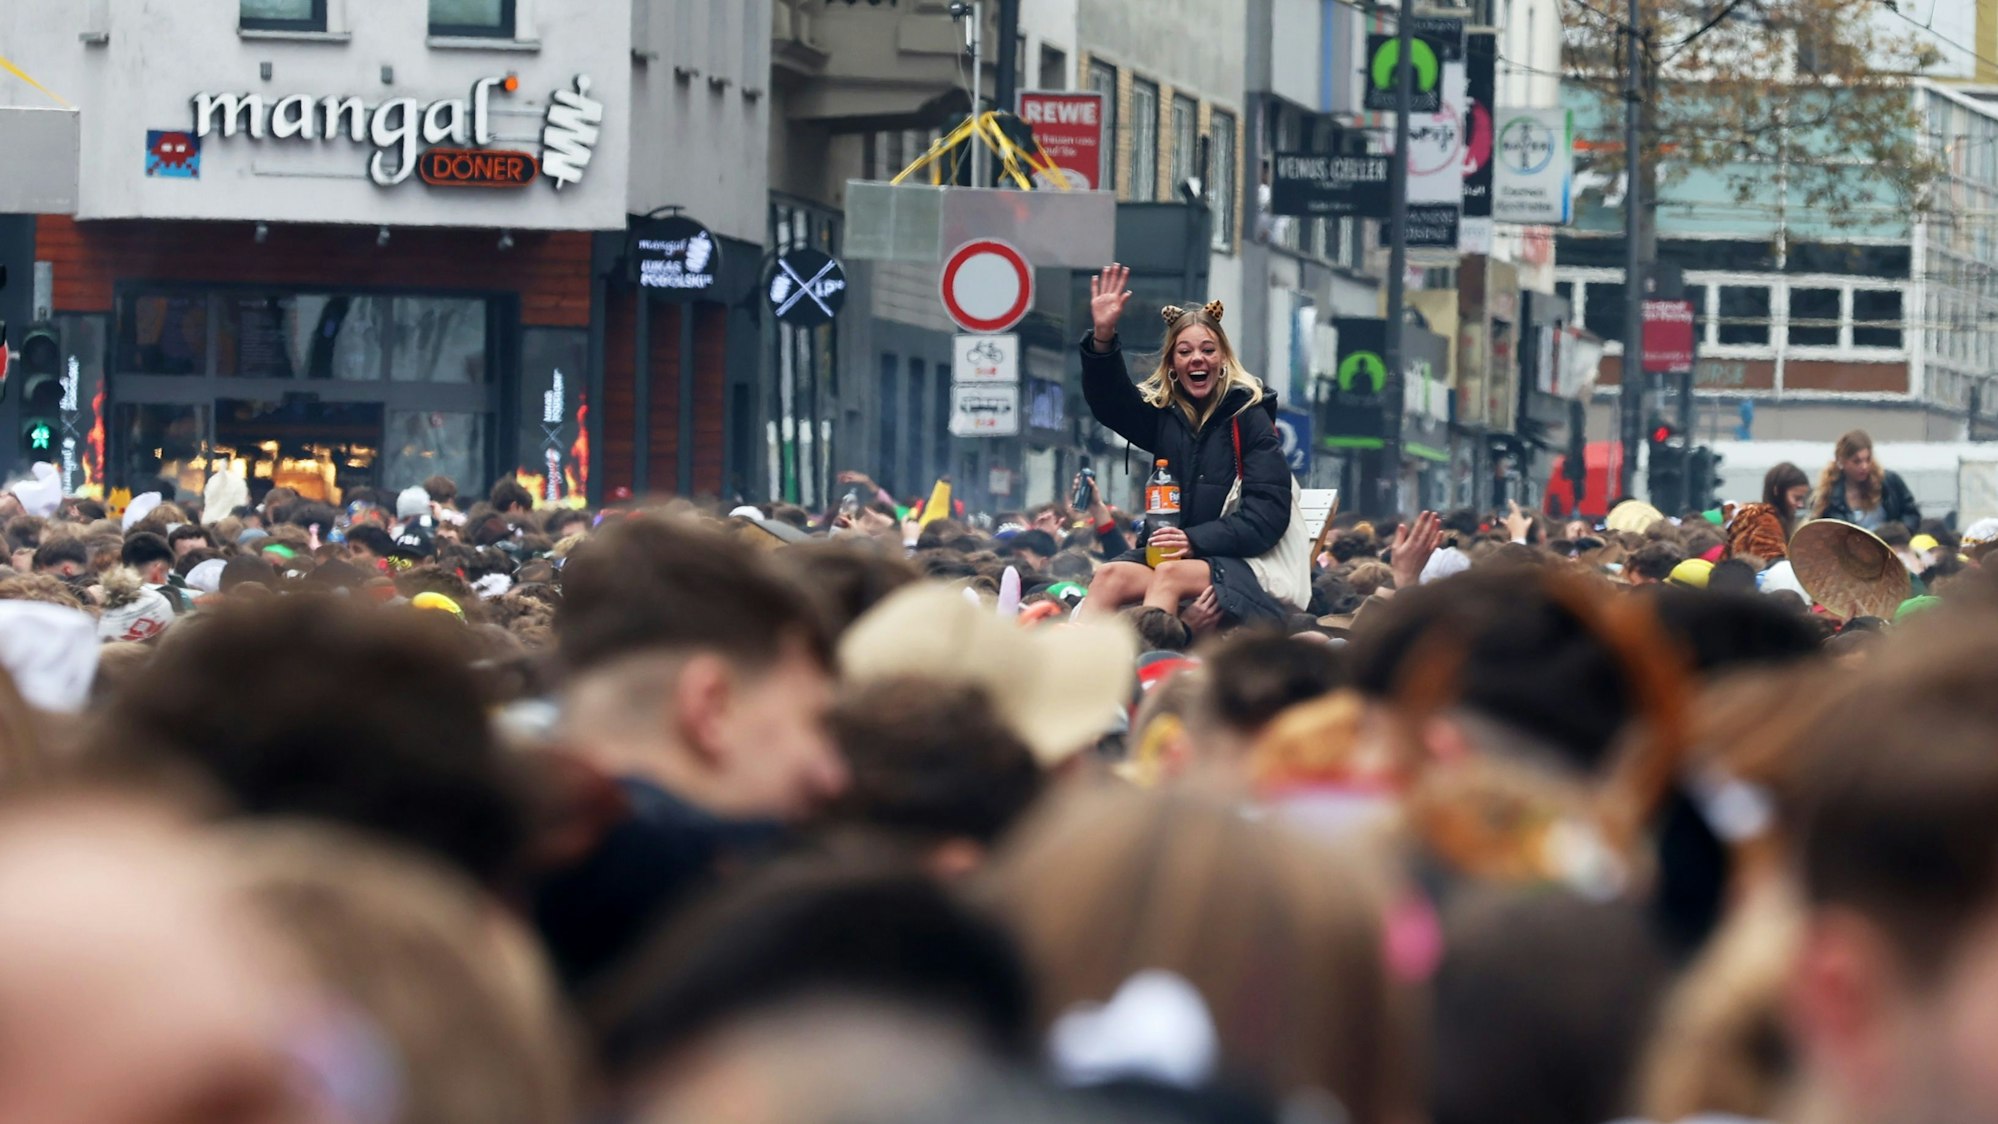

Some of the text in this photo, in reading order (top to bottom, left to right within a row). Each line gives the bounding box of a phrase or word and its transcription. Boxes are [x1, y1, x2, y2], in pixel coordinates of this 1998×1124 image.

[1024, 100, 1097, 125] REWE
[193, 76, 503, 185] mangal
[432, 150, 524, 182] DÖNER
[1277, 155, 1327, 179] VENUS
[397, 534, 420, 547] FBI
